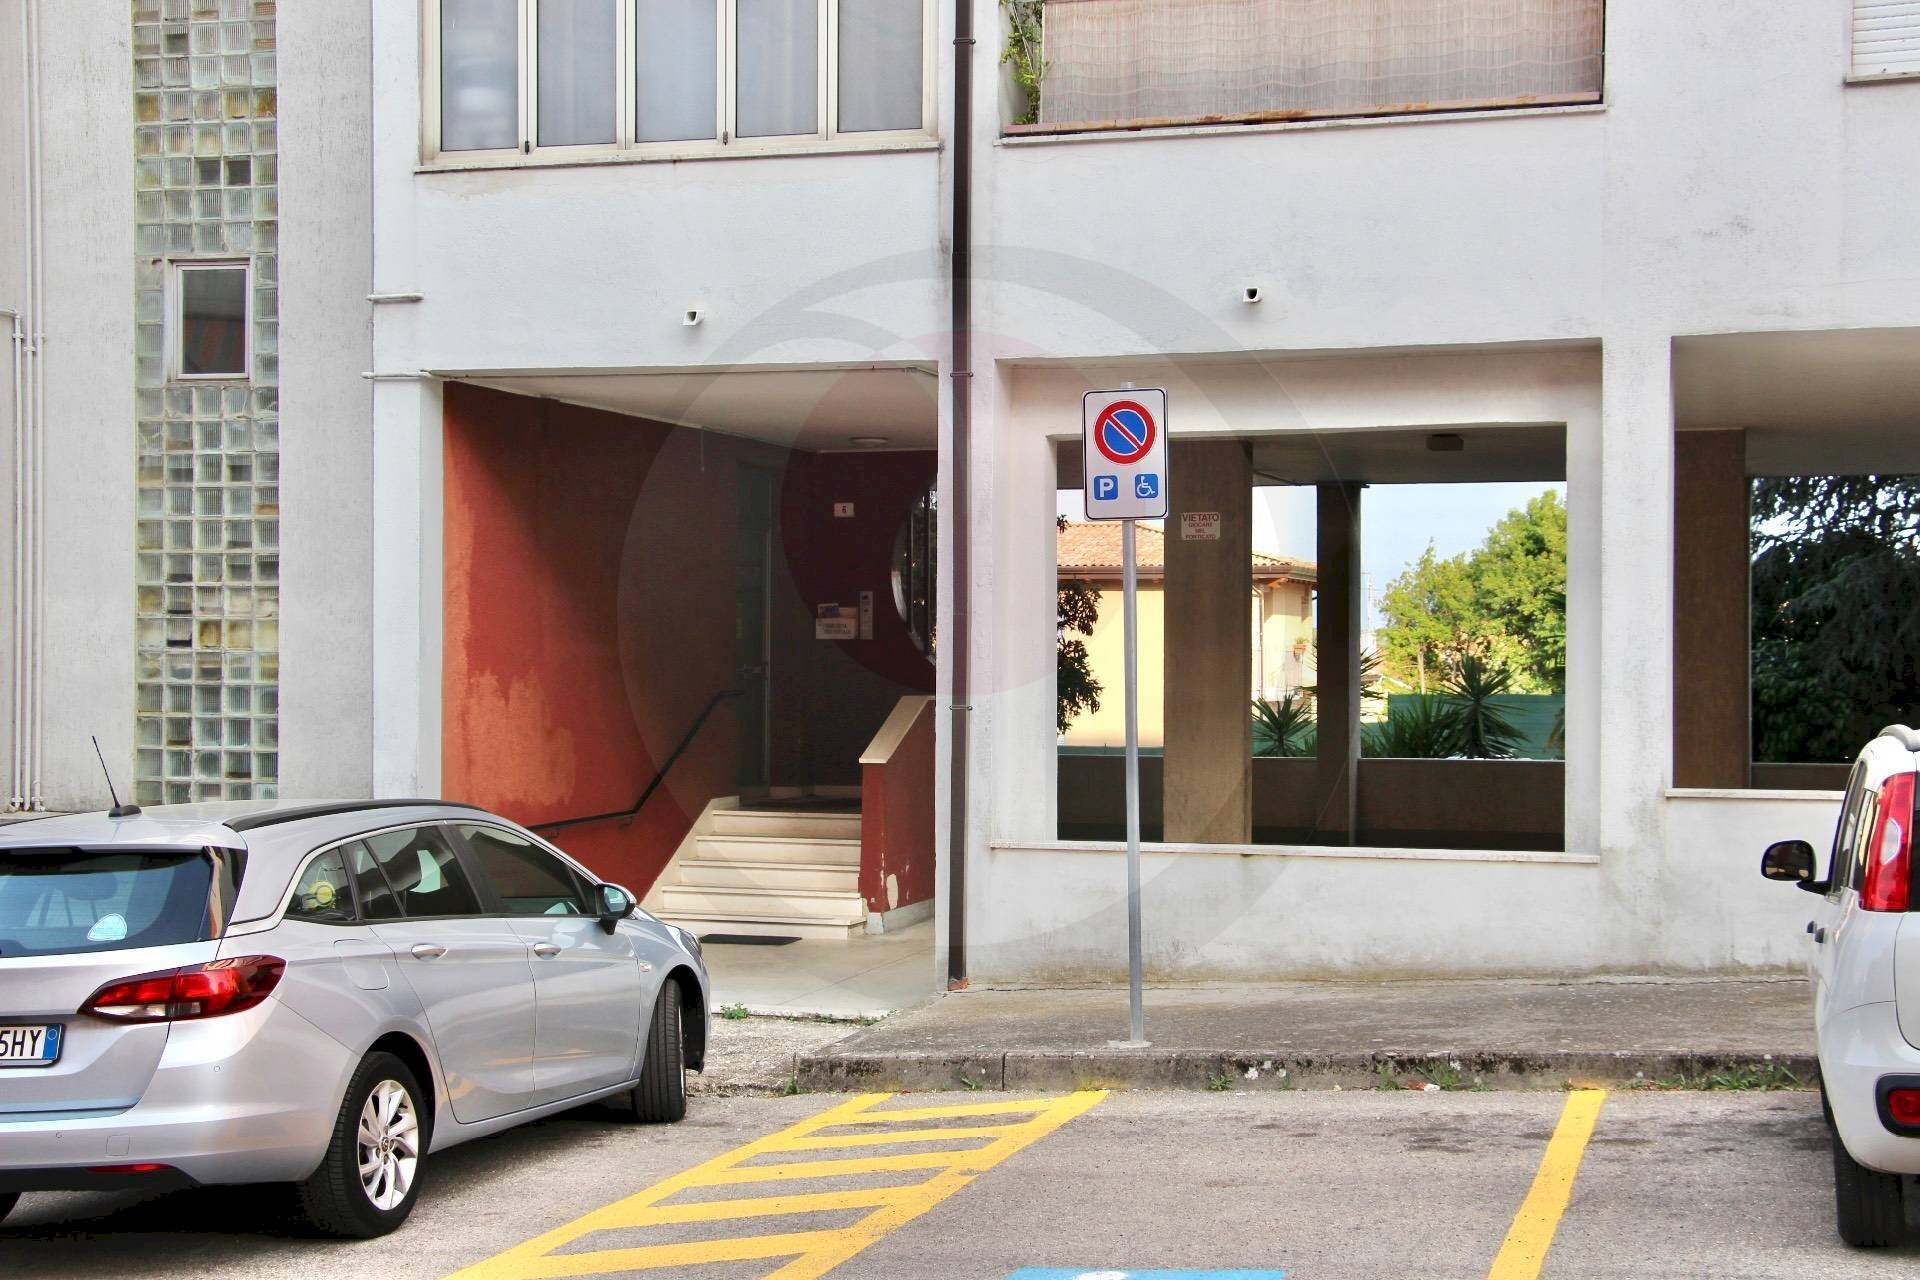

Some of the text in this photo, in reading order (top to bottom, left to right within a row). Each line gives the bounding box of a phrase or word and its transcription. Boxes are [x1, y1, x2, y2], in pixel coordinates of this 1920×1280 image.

[1099, 478, 1114, 498] P
[1182, 513, 1219, 522] VIETATO
[0, 1029, 42, 1057] 5HY
